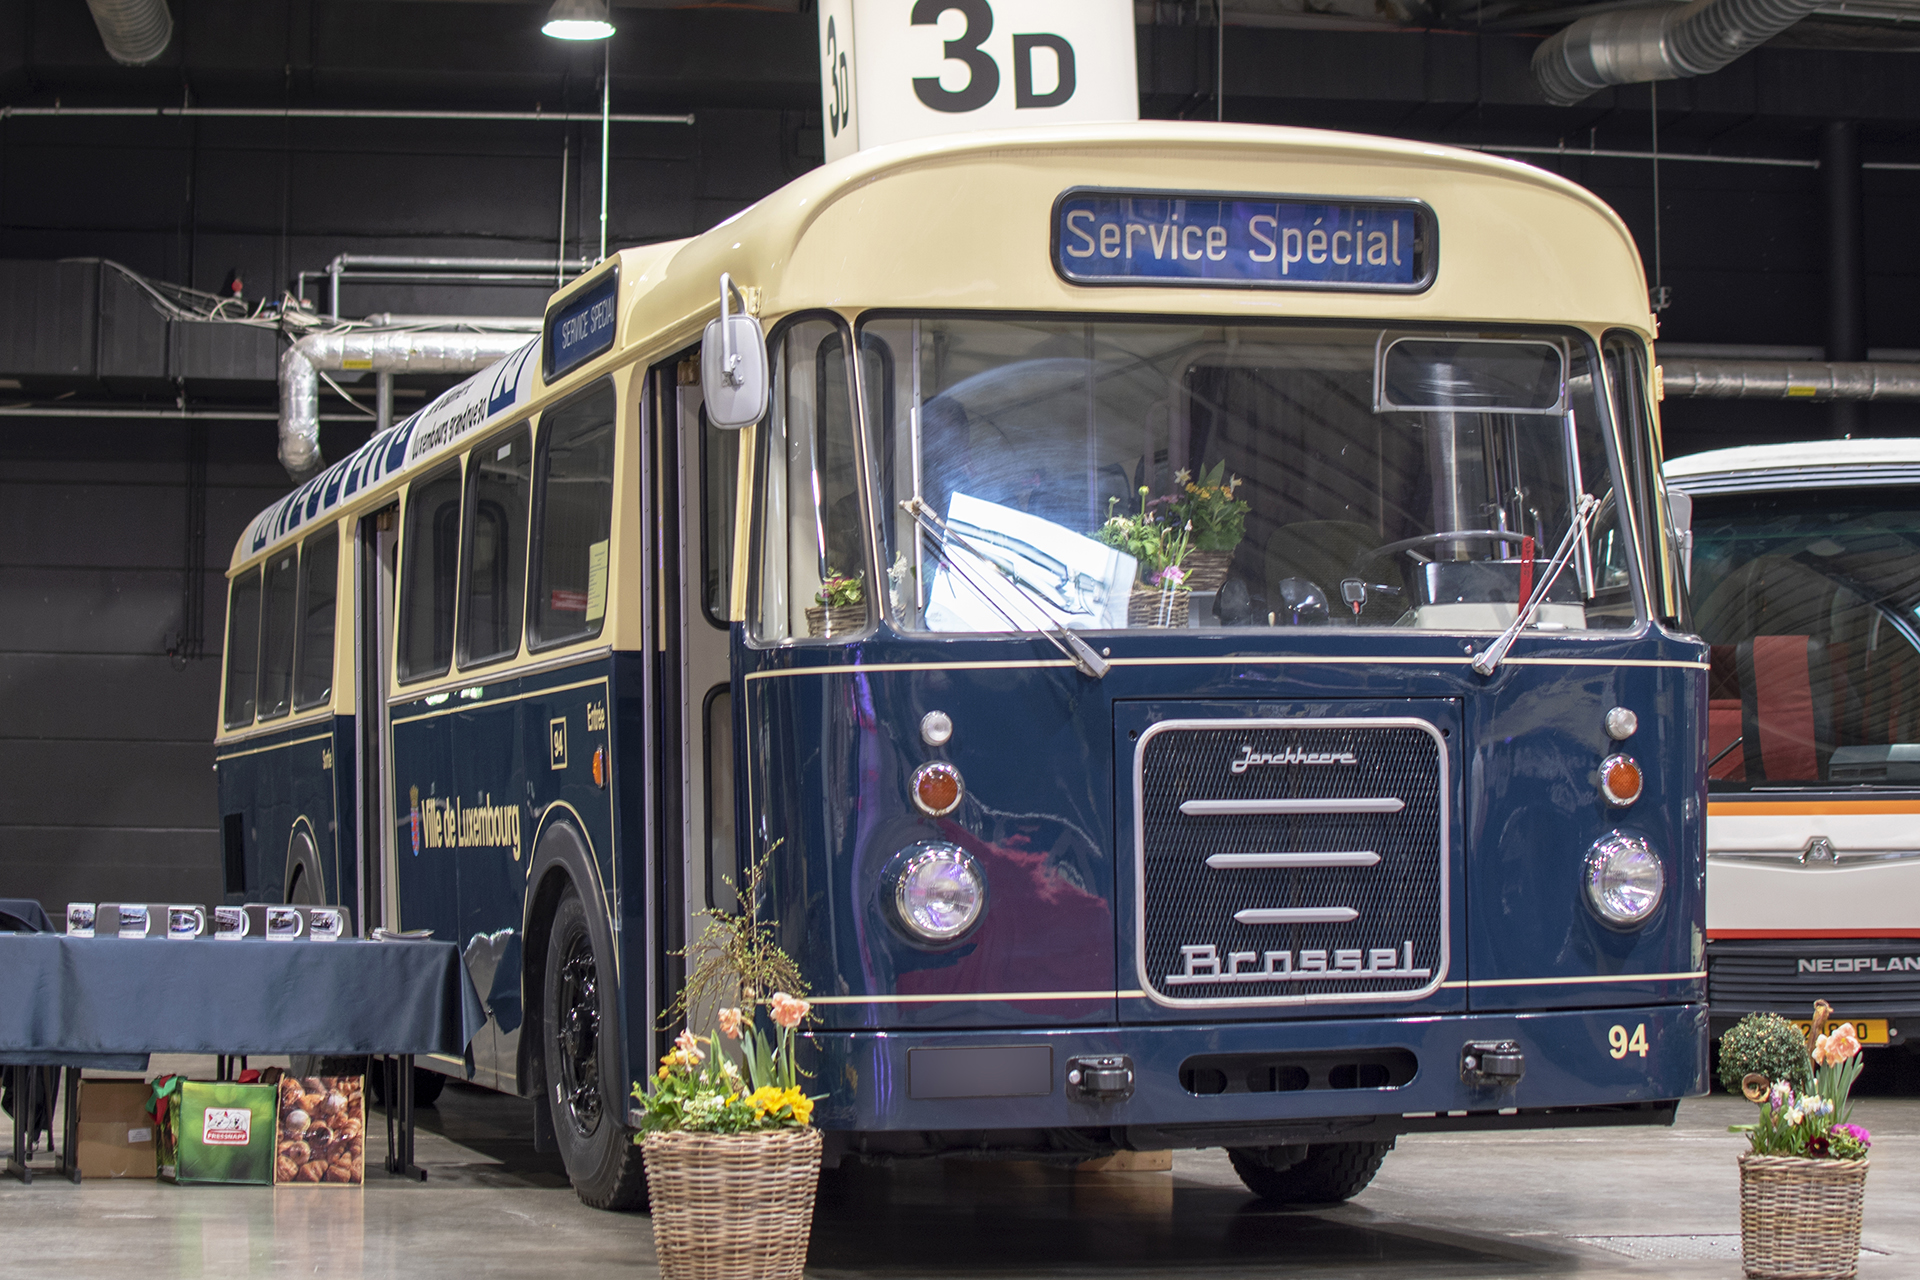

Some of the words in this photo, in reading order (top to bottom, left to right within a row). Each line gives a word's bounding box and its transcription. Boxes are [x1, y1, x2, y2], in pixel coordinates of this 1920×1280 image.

[827, 14, 850, 139] 3D
[911, 0, 1076, 113] 3D
[1065, 209, 1228, 261] Service
[1248, 214, 1402, 275] Spécial
[561, 309, 589, 350] SERVICE
[586, 700, 606, 732] Entrée
[553, 729, 563, 758] 94
[421, 797, 443, 849] Ville
[443, 796, 457, 848] de
[456, 792, 521, 862] Luxembourg
[1165, 940, 1431, 985] Brossel
[1798, 957, 1920, 972] NEOPLAN
[1608, 1024, 1650, 1060] 94
